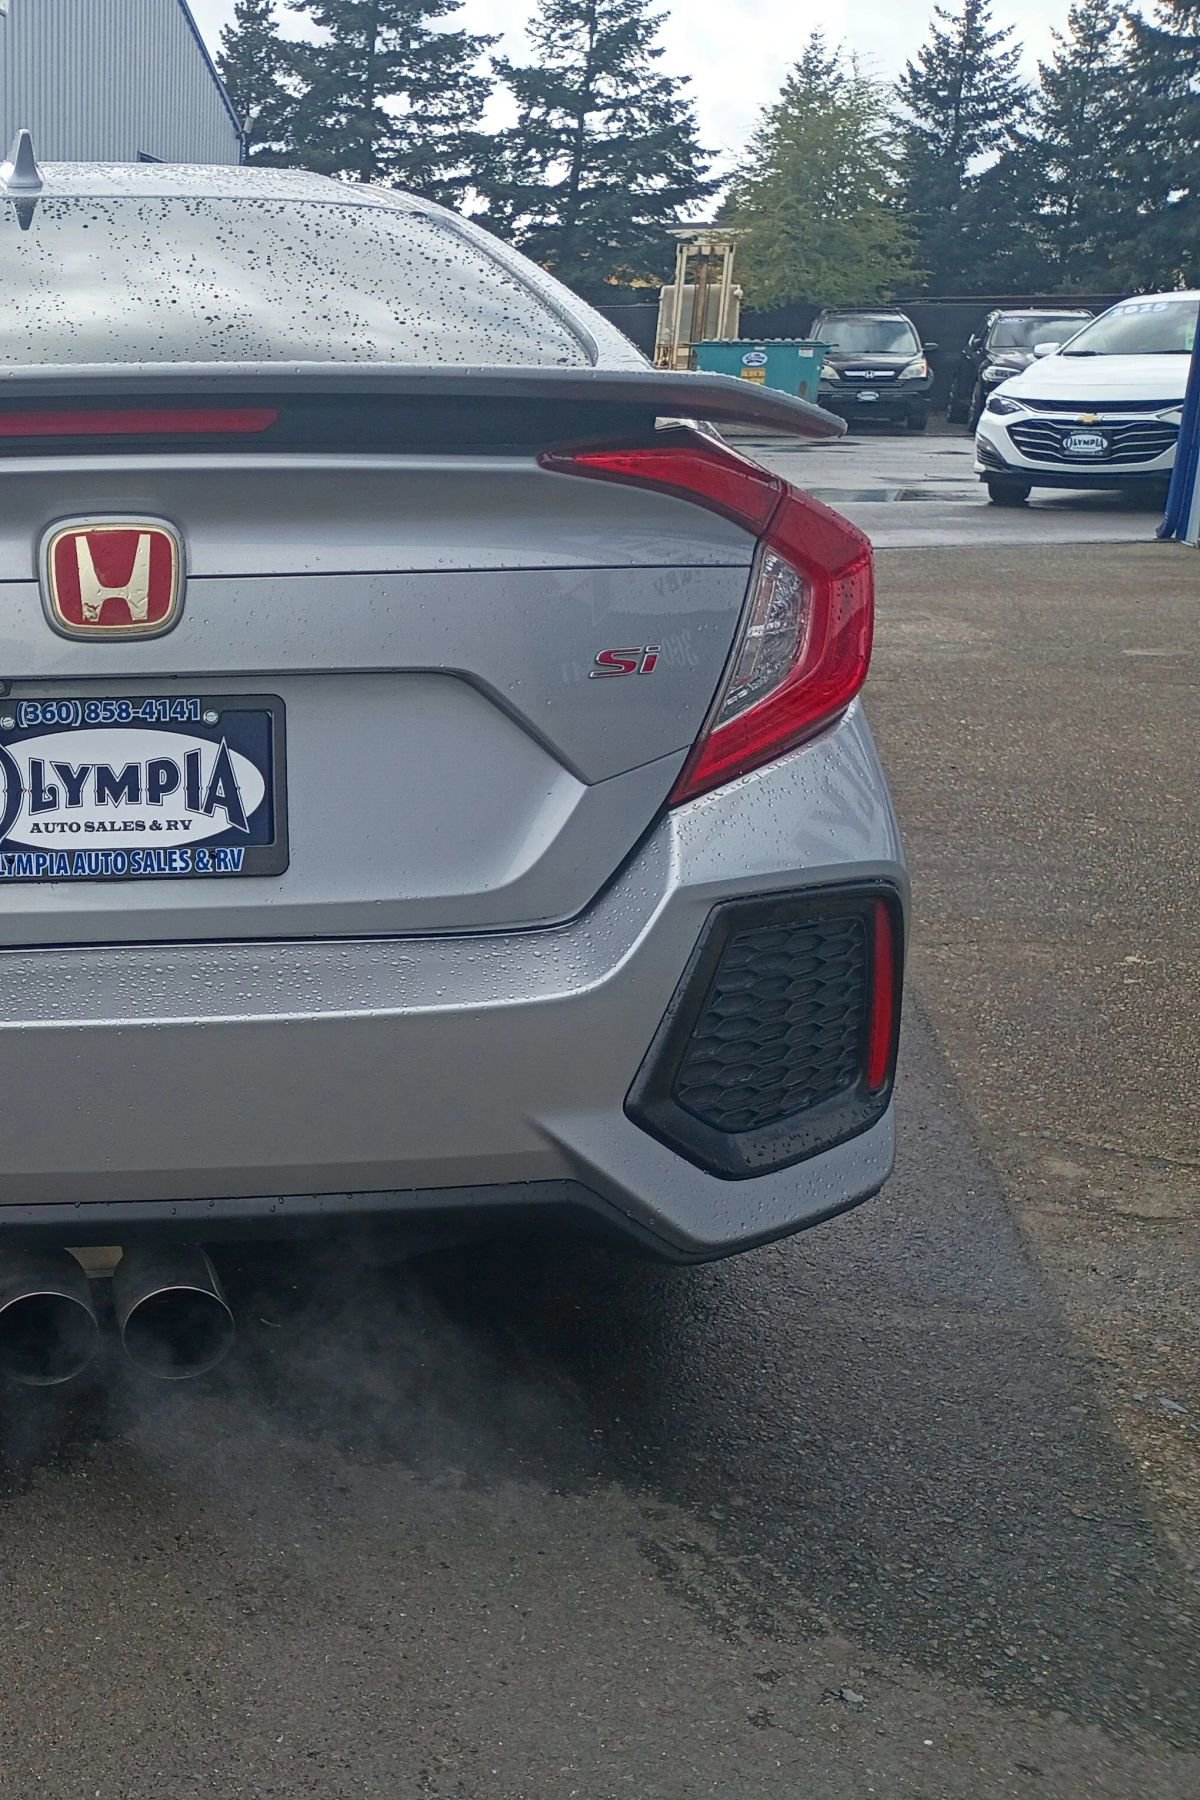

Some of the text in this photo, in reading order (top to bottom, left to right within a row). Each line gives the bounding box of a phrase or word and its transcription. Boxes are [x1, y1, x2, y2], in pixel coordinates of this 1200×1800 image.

[1109, 302, 1169, 318] 2025
[1065, 436, 1105, 450] OLYMPIA
[589, 645, 661, 679] Si
[16, 699, 201, 728] (360) 858-4141
[30, 820, 193, 834] AUTO SALES & RV
[73, 851, 128, 876] AUTO
[130, 849, 192, 874] SALES
[194, 849, 212, 872] &
[215, 847, 245, 872] RV
